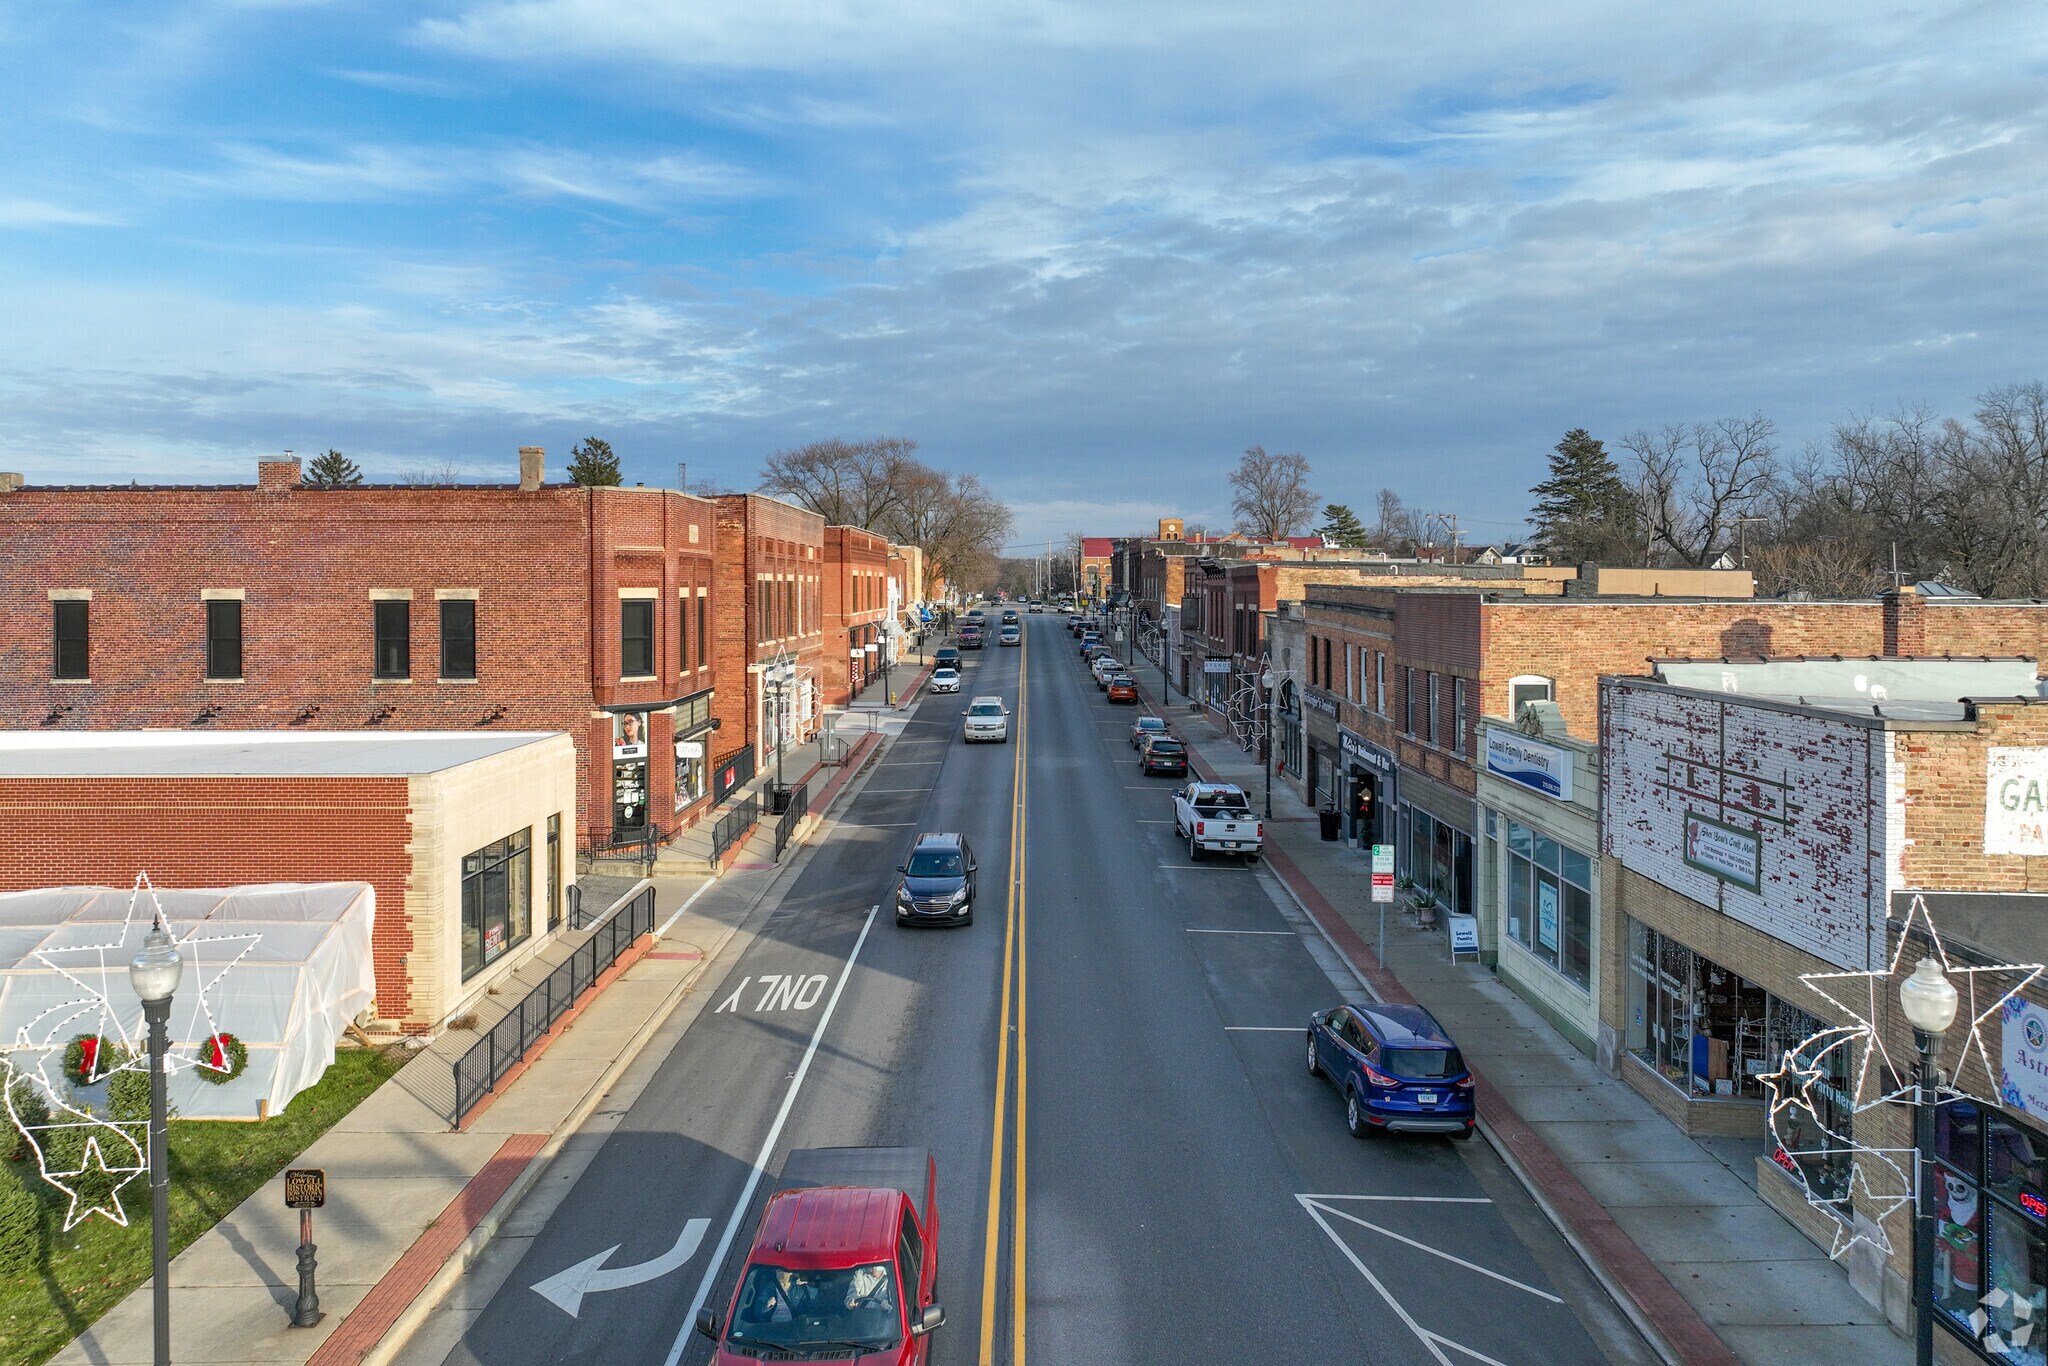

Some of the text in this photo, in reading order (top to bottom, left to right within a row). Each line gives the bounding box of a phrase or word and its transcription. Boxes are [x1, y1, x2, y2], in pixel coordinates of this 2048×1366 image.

[1489, 737, 1504, 752] Lowell
[1505, 742, 1523, 762] Family
[1523, 749, 1549, 772] Dentistry
[1999, 778, 2048, 811] GA
[1374, 846, 1379, 855] 2
[714, 974, 829, 1013] ONLY
[1773, 1148, 1795, 1171] OPEN
[287, 1177, 321, 1185] LOWELL
[2019, 1192, 2048, 1217] OPE
